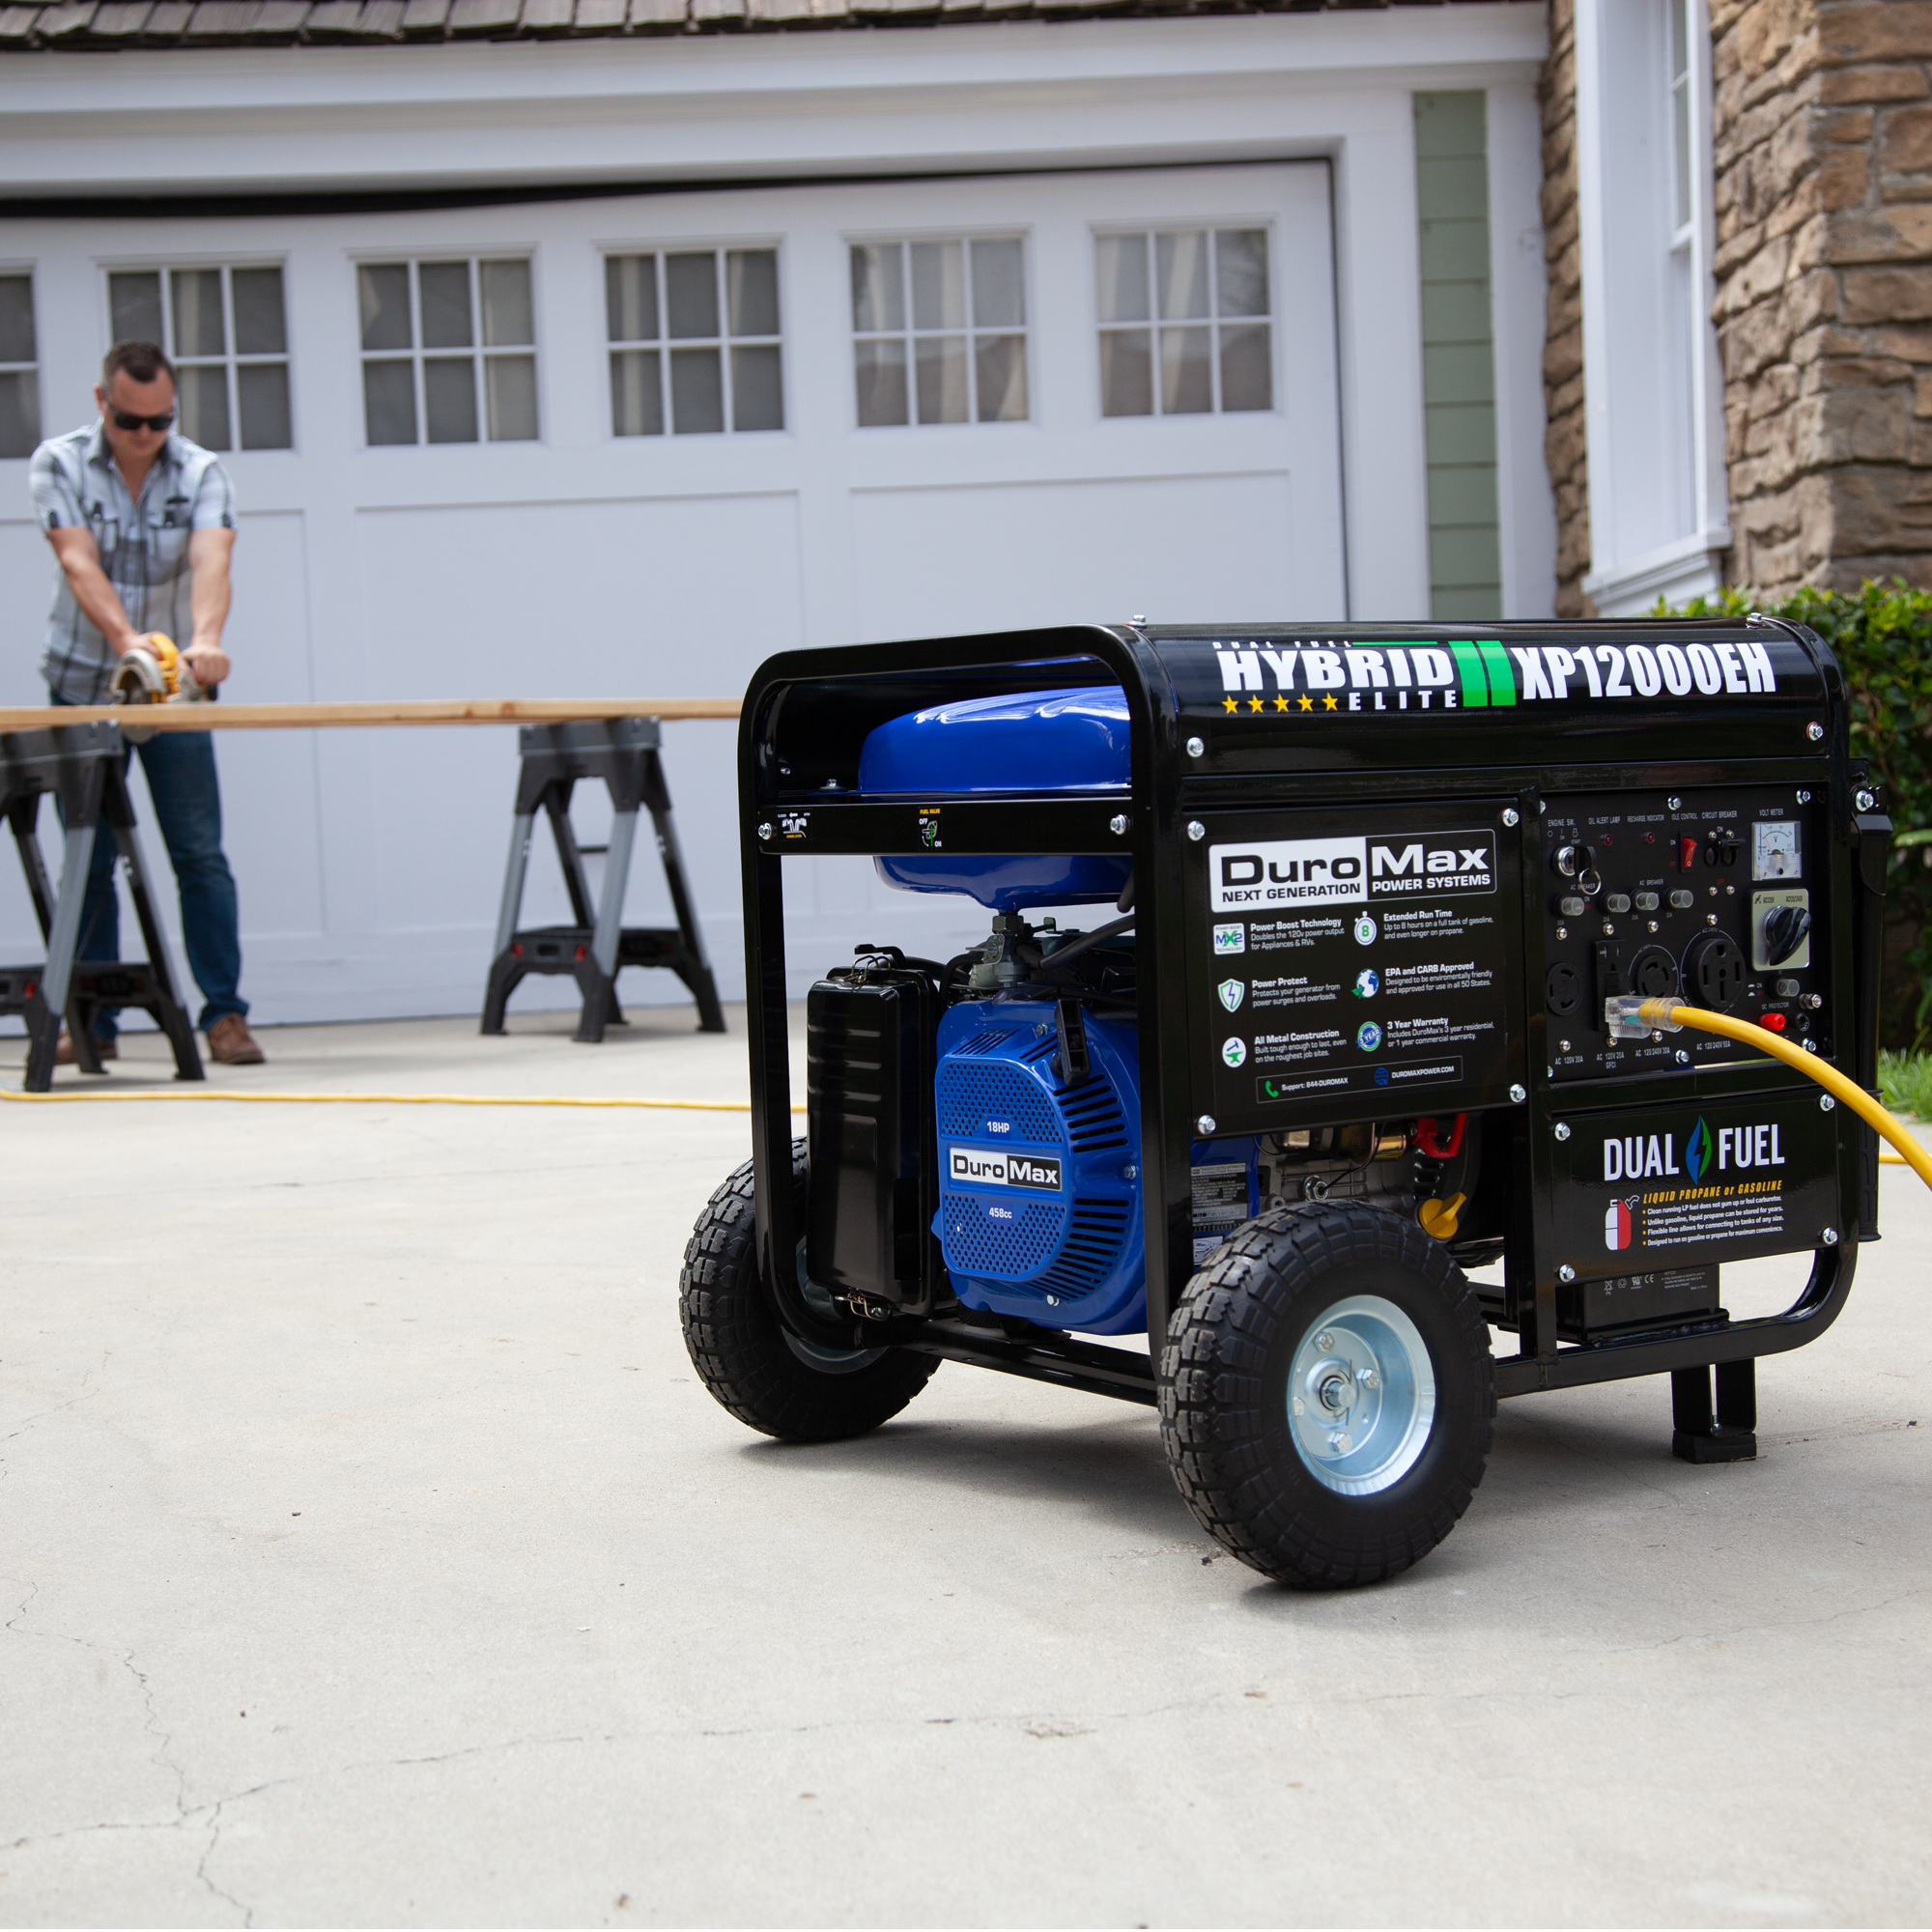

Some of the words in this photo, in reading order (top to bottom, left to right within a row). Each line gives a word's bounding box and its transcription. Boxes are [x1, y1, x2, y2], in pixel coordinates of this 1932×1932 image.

[1216, 648, 1454, 691] HYBRID
[1510, 643, 1776, 699] XP12000EH
[1349, 690, 1457, 711] ELITE
[1609, 815, 1621, 824] LAMP
[1372, 879, 1423, 893] POWER
[1426, 874, 1491, 889] SYSTEMS
[1223, 889, 1262, 902] NEXT
[1266, 883, 1360, 900] GENERATION
[1383, 912, 1417, 922] Extended
[1435, 909, 1453, 918] Time
[1468, 916, 1493, 925] gasoline,
[1250, 923, 1275, 932] Power
[1300, 918, 1342, 927] Technology
[1362, 924, 1370, 937] 8
[1438, 927, 1464, 936] propane.
[1305, 930, 1323, 939] power
[1324, 927, 1345, 936] output
[1262, 941, 1293, 951] Appliances
[1385, 968, 1401, 977] EPA
[1403, 966, 1415, 976] and
[1417, 964, 1439, 974] CARB
[1439, 961, 1474, 974] Approved
[1252, 980, 1277, 988] Power
[1277, 977, 1308, 986] Protect
[1385, 977, 1412, 986] Designed
[1471, 970, 1492, 979] friendly
[1252, 989, 1280, 998] Protects
[1280, 988, 1293, 997] your
[1294, 985, 1325, 995] generator
[1398, 984, 1425, 994] approved
[1252, 999, 1272, 1009] power
[1272, 997, 1293, 1006] surges
[1307, 992, 1337, 1002] overloads.
[1387, 1021, 1393, 1030] 3
[1394, 1020, 1411, 1029] Year
[1412, 1017, 1448, 1028] Warranty
[1387, 1030, 1411, 1038] Includes
[1412, 1026, 1443, 1037] DuroMax's
[1463, 1022, 1494, 1031] residential,
[1255, 1036, 1265, 1045] All
[1266, 1034, 1289, 1043] Metal
[1290, 1029, 1340, 1041] Construction
[1364, 1029, 1379, 1040] YEAR
[1415, 1035, 1449, 1044] commercial
[1255, 1045, 1269, 1054] Built
[1270, 1044, 1288, 1053] tough
[1289, 1042, 1310, 1051] enough
[1275, 1052, 1303, 1062] roughest
[1314, 1049, 1330, 1058] sites.
[1555, 1057, 1561, 1065] AC
[1564, 1056, 1575, 1065] 120V
[1605, 1052, 1616, 1061] 120V
[1391, 1065, 1454, 1078] DUROMAXPOWER.COM
[1605, 1061, 1616, 1069] GFCI
[1282, 1082, 1305, 1092] Support:
[1306, 1077, 1349, 1088] 844-DUROMAX
[987, 1122, 1010, 1133] 18HP
[1604, 1133, 1680, 1181] DUAL
[1719, 1123, 1785, 1170] FUEL
[1643, 1190, 1676, 1204] LIQUID
[1679, 1186, 1721, 1200] PROPANE
[1723, 1186, 1735, 1196] or
[1738, 1180, 1782, 1194] GASOLINE
[989, 1207, 1012, 1219] 458cc
